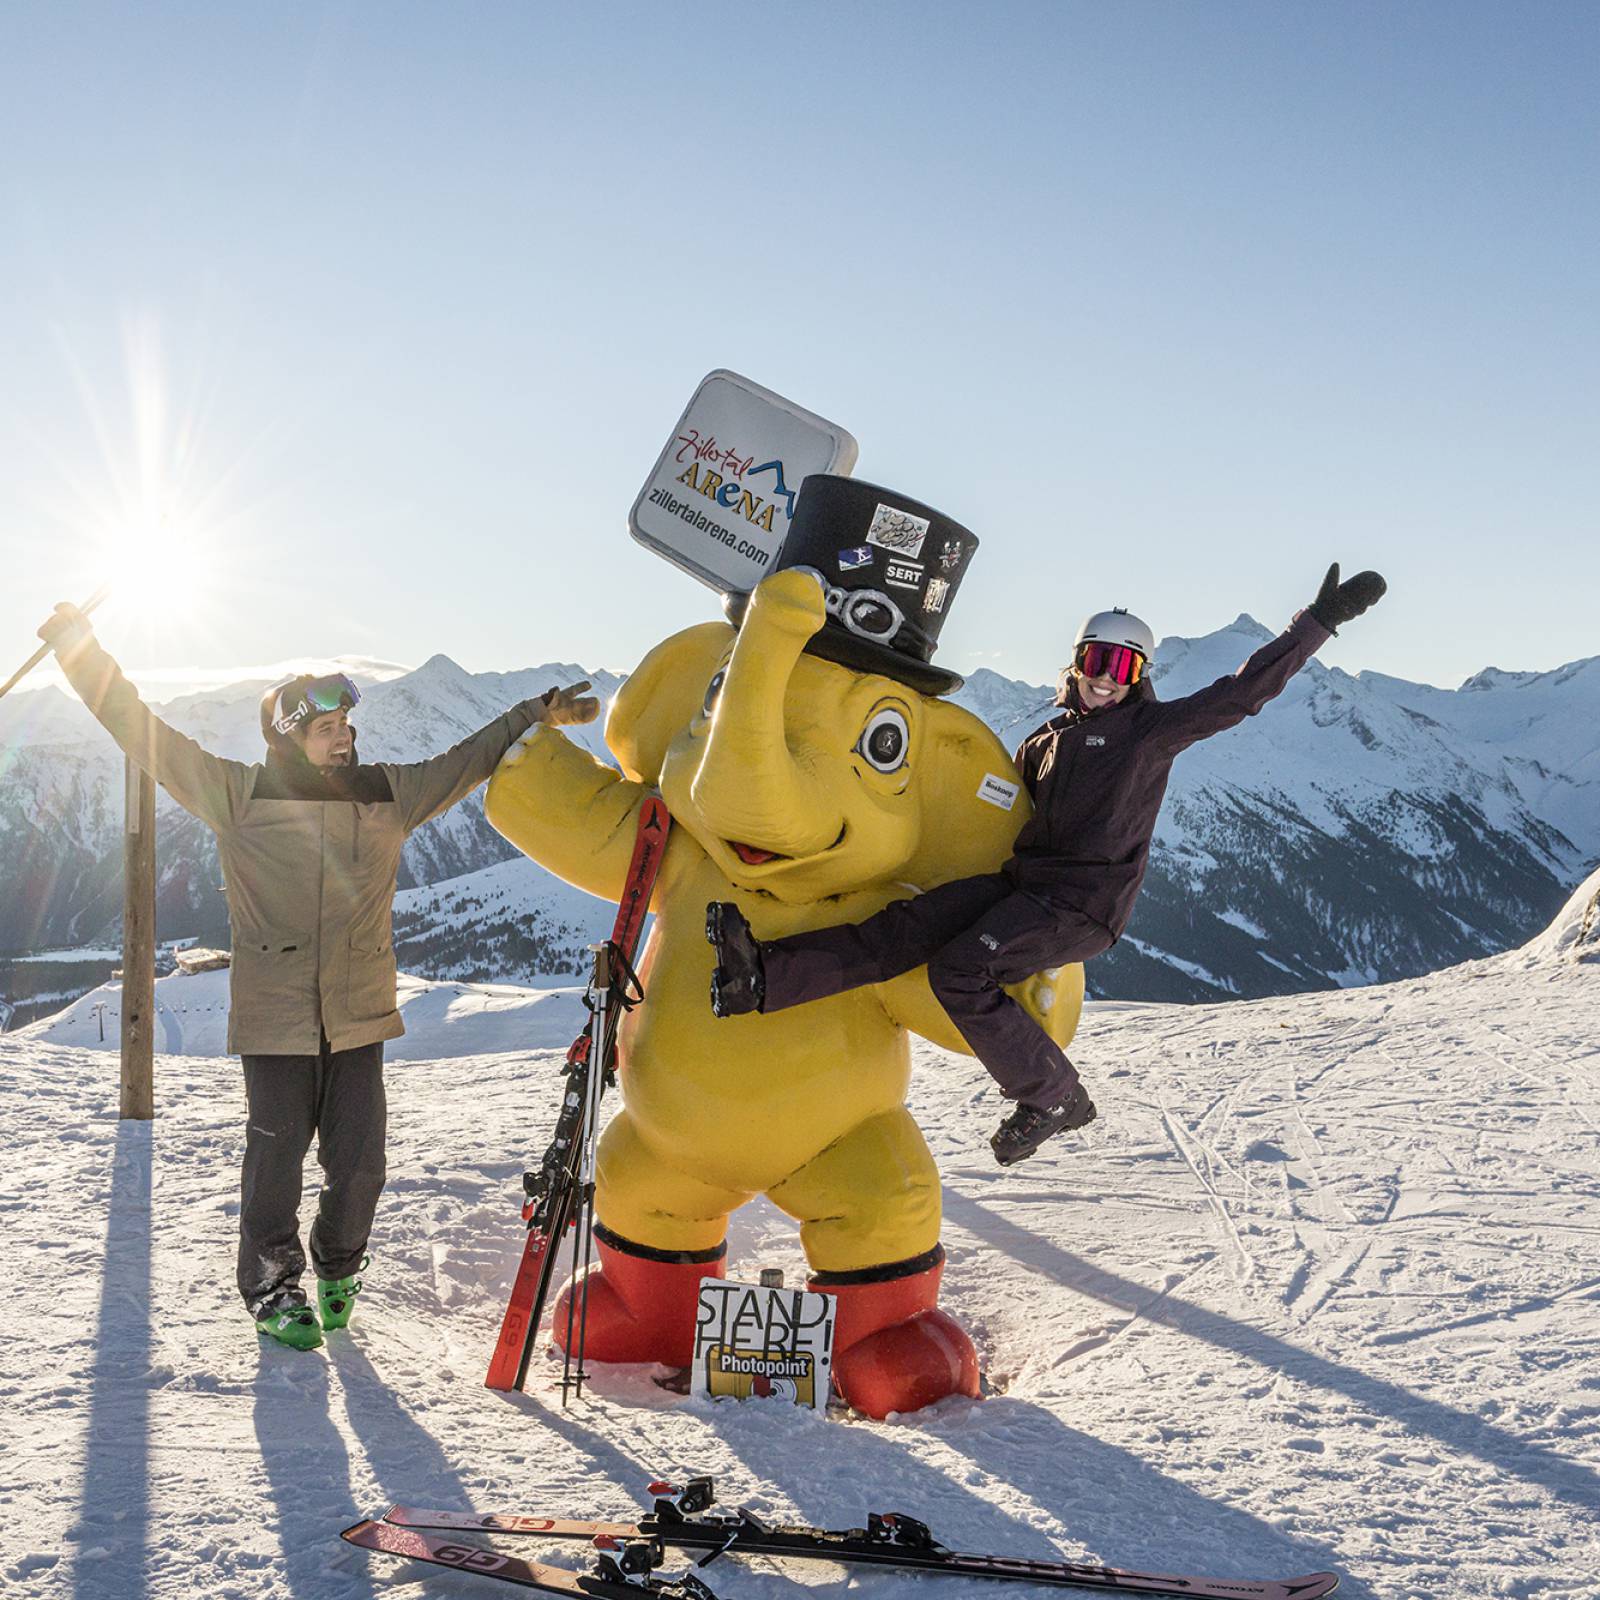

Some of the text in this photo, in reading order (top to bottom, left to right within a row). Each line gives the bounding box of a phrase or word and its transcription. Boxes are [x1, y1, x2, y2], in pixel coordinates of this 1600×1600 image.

[648, 488, 769, 566] zillertalarena.com
[886, 565, 923, 583] SERT
[699, 1286, 829, 1330] STAND
[721, 1354, 808, 1376] Photopoint
[1205, 1583, 1265, 1594] ATOMIC
